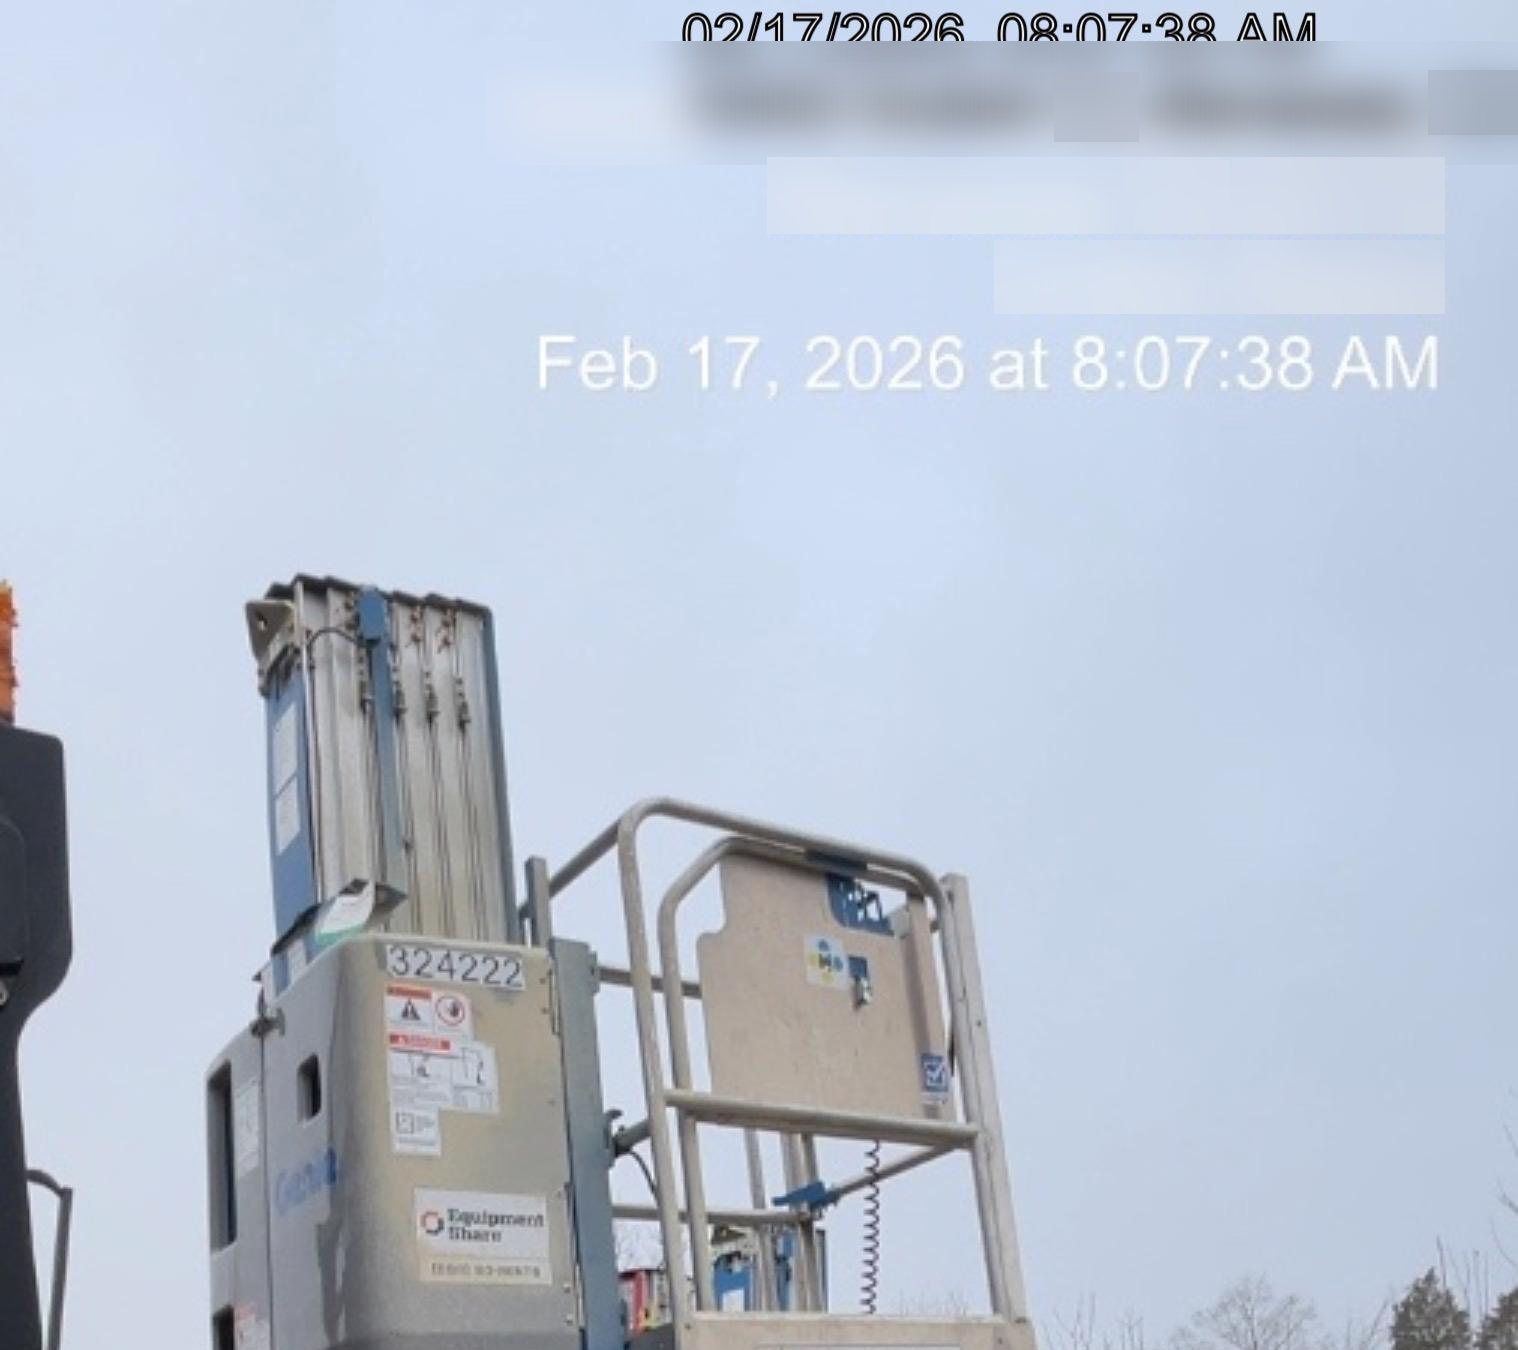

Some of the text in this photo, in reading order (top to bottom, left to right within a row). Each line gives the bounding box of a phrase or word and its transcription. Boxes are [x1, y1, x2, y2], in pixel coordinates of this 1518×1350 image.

[389, 946, 523, 987] 324222
[446, 1207, 545, 1228] Equipment
[448, 1225, 502, 1243] Share
